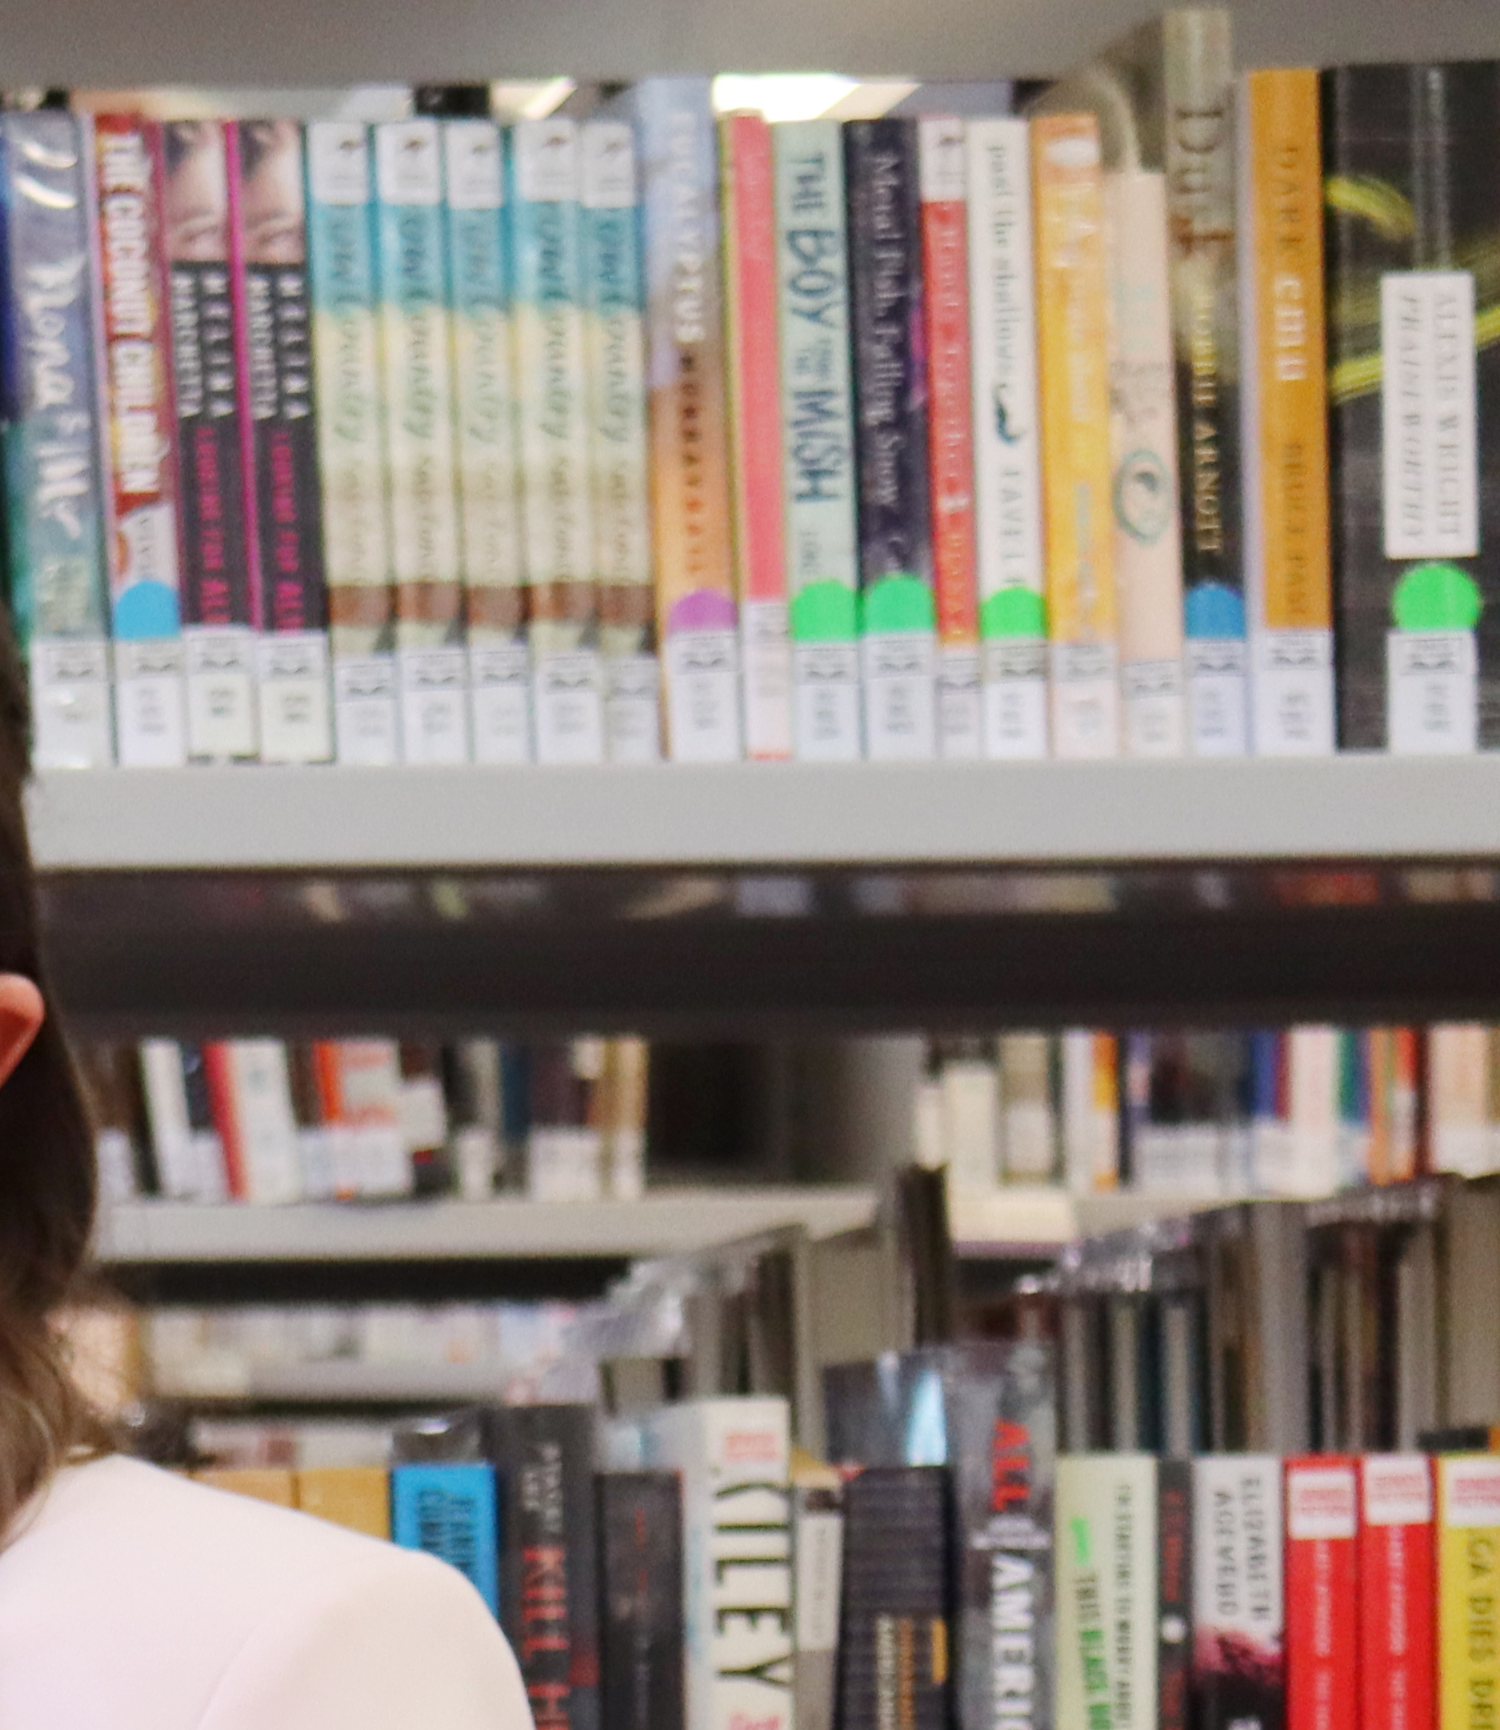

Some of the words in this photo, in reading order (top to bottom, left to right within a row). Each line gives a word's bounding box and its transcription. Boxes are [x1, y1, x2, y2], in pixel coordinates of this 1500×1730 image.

[790, 155, 829, 213] THE
[873, 152, 904, 239] Metal
[993, 209, 1019, 247] the
[1277, 141, 1305, 253] DARK
[788, 228, 846, 330] BOY
[994, 257, 1019, 377] shallows
[1275, 271, 1307, 381] EMU
[1434, 294, 1462, 404] ALEXIS
[788, 390, 844, 503] MISH
[1192, 423, 1219, 552] ARNOTT
[1435, 412, 1464, 539] WRIGHT
[991, 1419, 1032, 1512] ALL
[1213, 1489, 1241, 1618] ACEVEDO
[1240, 1477, 1274, 1623] ELIZABETH
[1466, 1594, 1498, 1663] DIES
